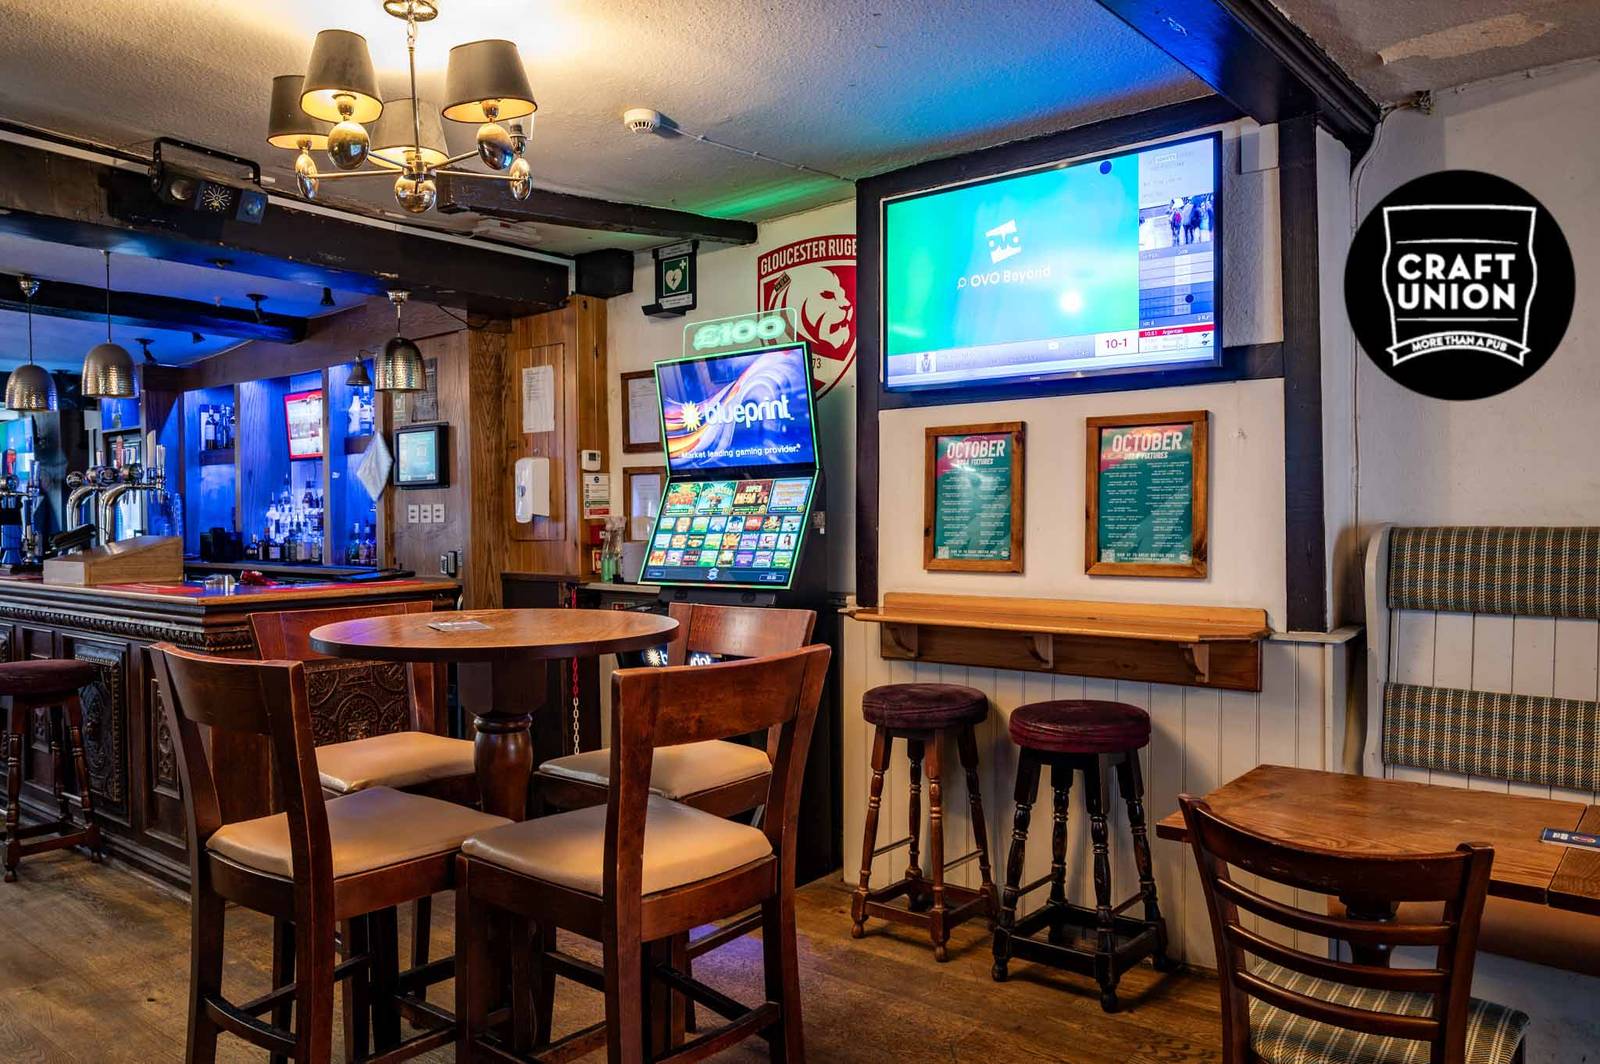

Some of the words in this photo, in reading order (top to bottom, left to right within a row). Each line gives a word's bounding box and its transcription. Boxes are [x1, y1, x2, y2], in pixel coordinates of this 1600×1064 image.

[760, 240, 826, 276] GLOUCESTER
[970, 271, 1000, 287] OVO
[1003, 265, 1051, 283] Beyond
[693, 315, 786, 350] £100
[1105, 338, 1128, 349] 10-1
[704, 394, 791, 428] blueprint
[946, 440, 1006, 459] OCTOBER
[1112, 431, 1183, 452] OCTOBER
[681, 450, 706, 459] Market
[707, 448, 734, 458] leading
[735, 447, 763, 457] gaming
